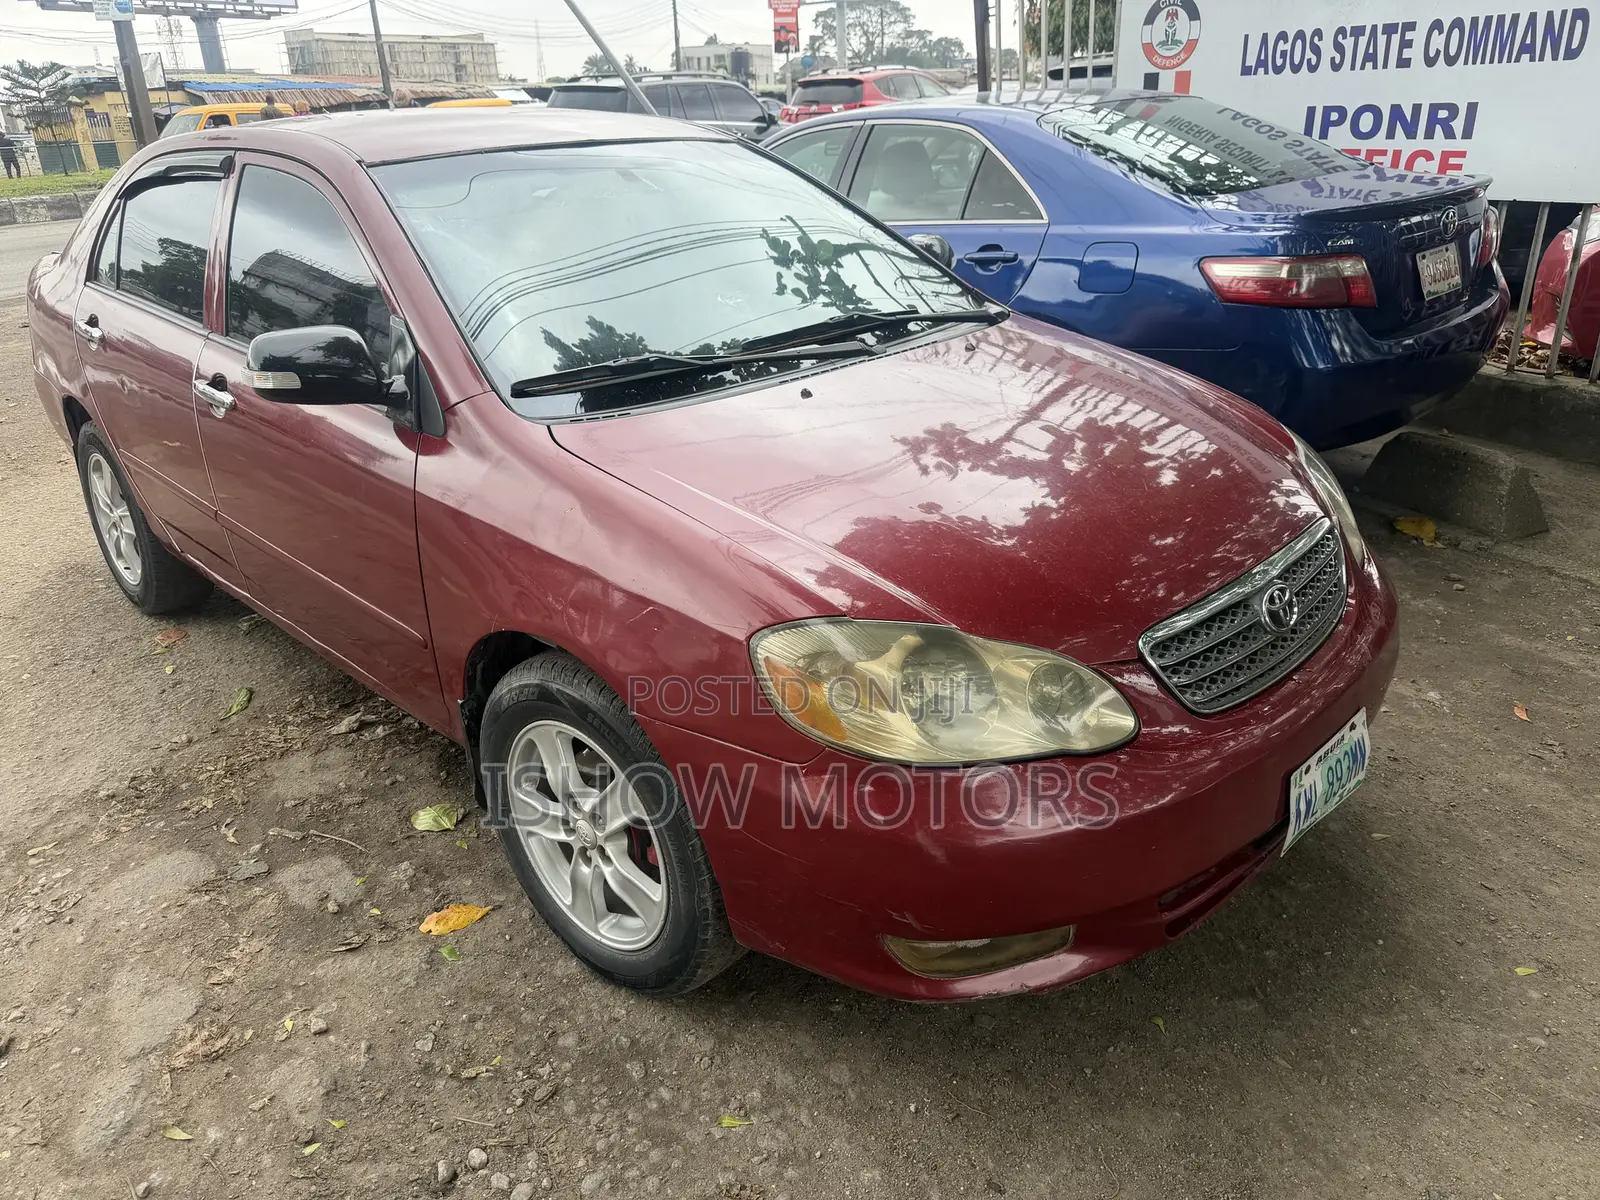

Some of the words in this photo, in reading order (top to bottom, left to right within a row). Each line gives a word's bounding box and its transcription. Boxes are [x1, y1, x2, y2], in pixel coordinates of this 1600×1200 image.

[1152, 52, 1187, 67] DEFENCE
[1240, 28, 1324, 76] LAGOS
[1330, 21, 1417, 72] STATE
[1423, 7, 1590, 68] COMMAND
[1303, 101, 1479, 140] IPONRI
